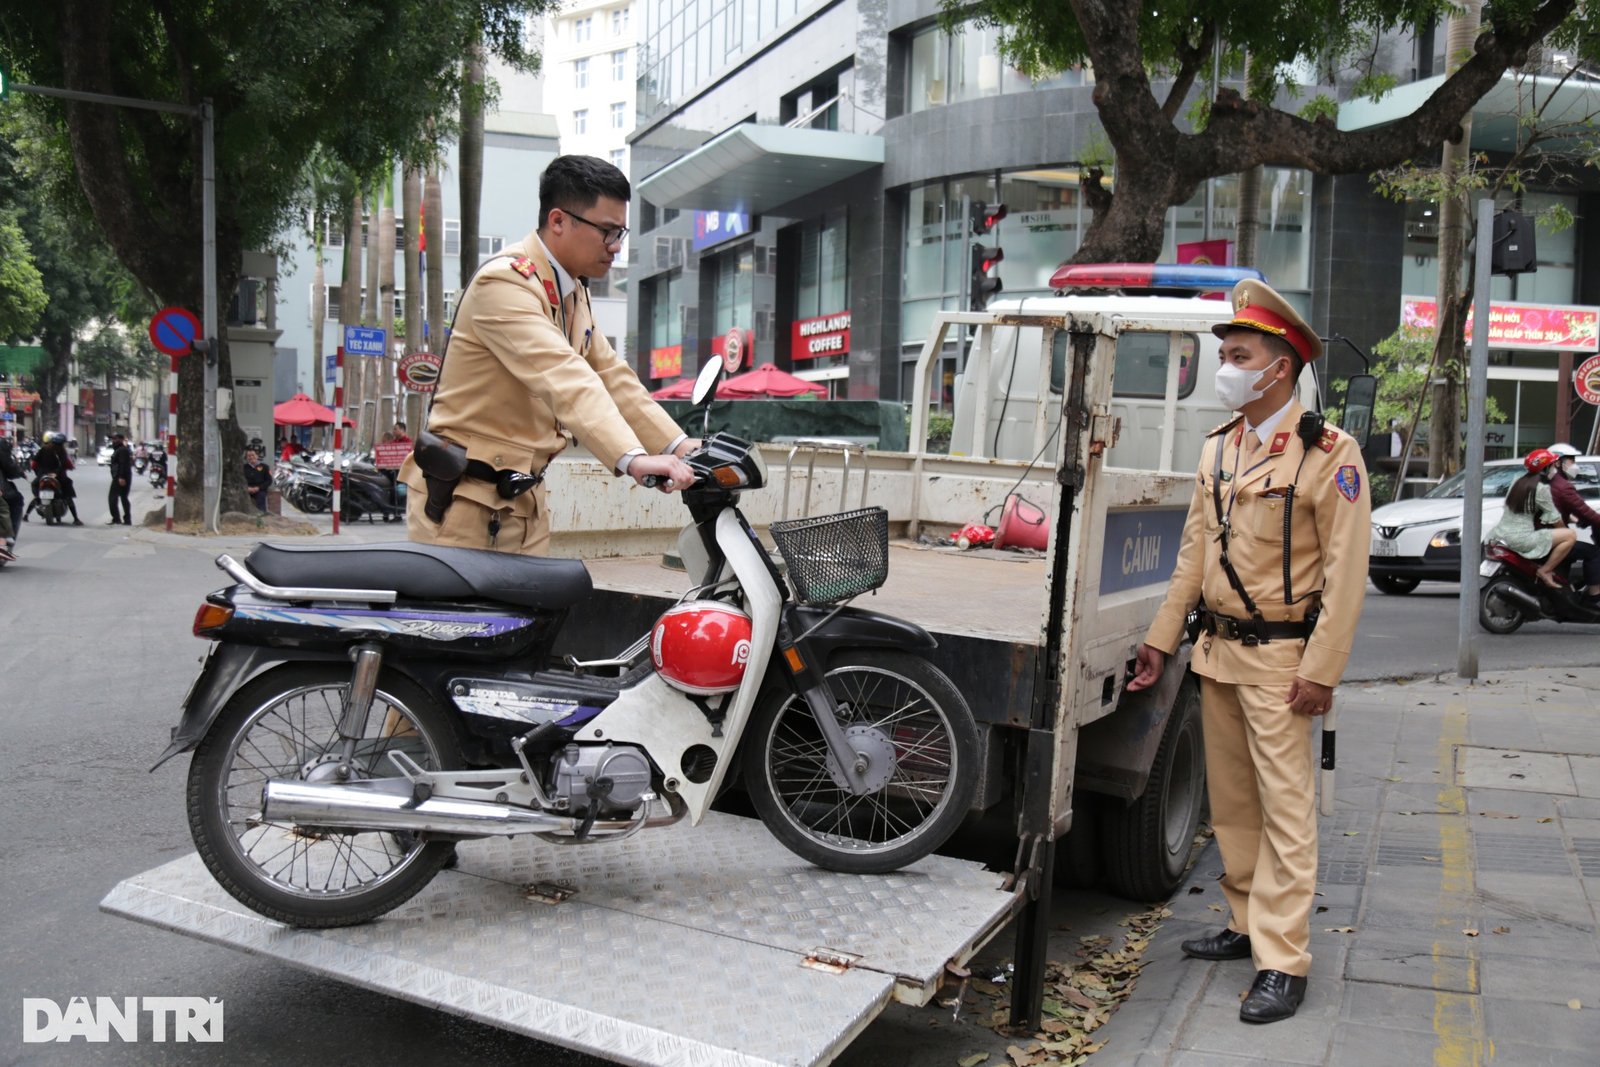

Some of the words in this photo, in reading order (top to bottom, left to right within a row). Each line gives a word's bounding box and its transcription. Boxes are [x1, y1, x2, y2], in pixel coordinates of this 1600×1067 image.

[363, 341, 383, 352] XANH
[808, 335, 843, 353] COFFEE
[401, 354, 441, 370] HIGHLAN
[1122, 521, 1161, 576] CẢNH
[469, 688, 519, 700] HONDA
